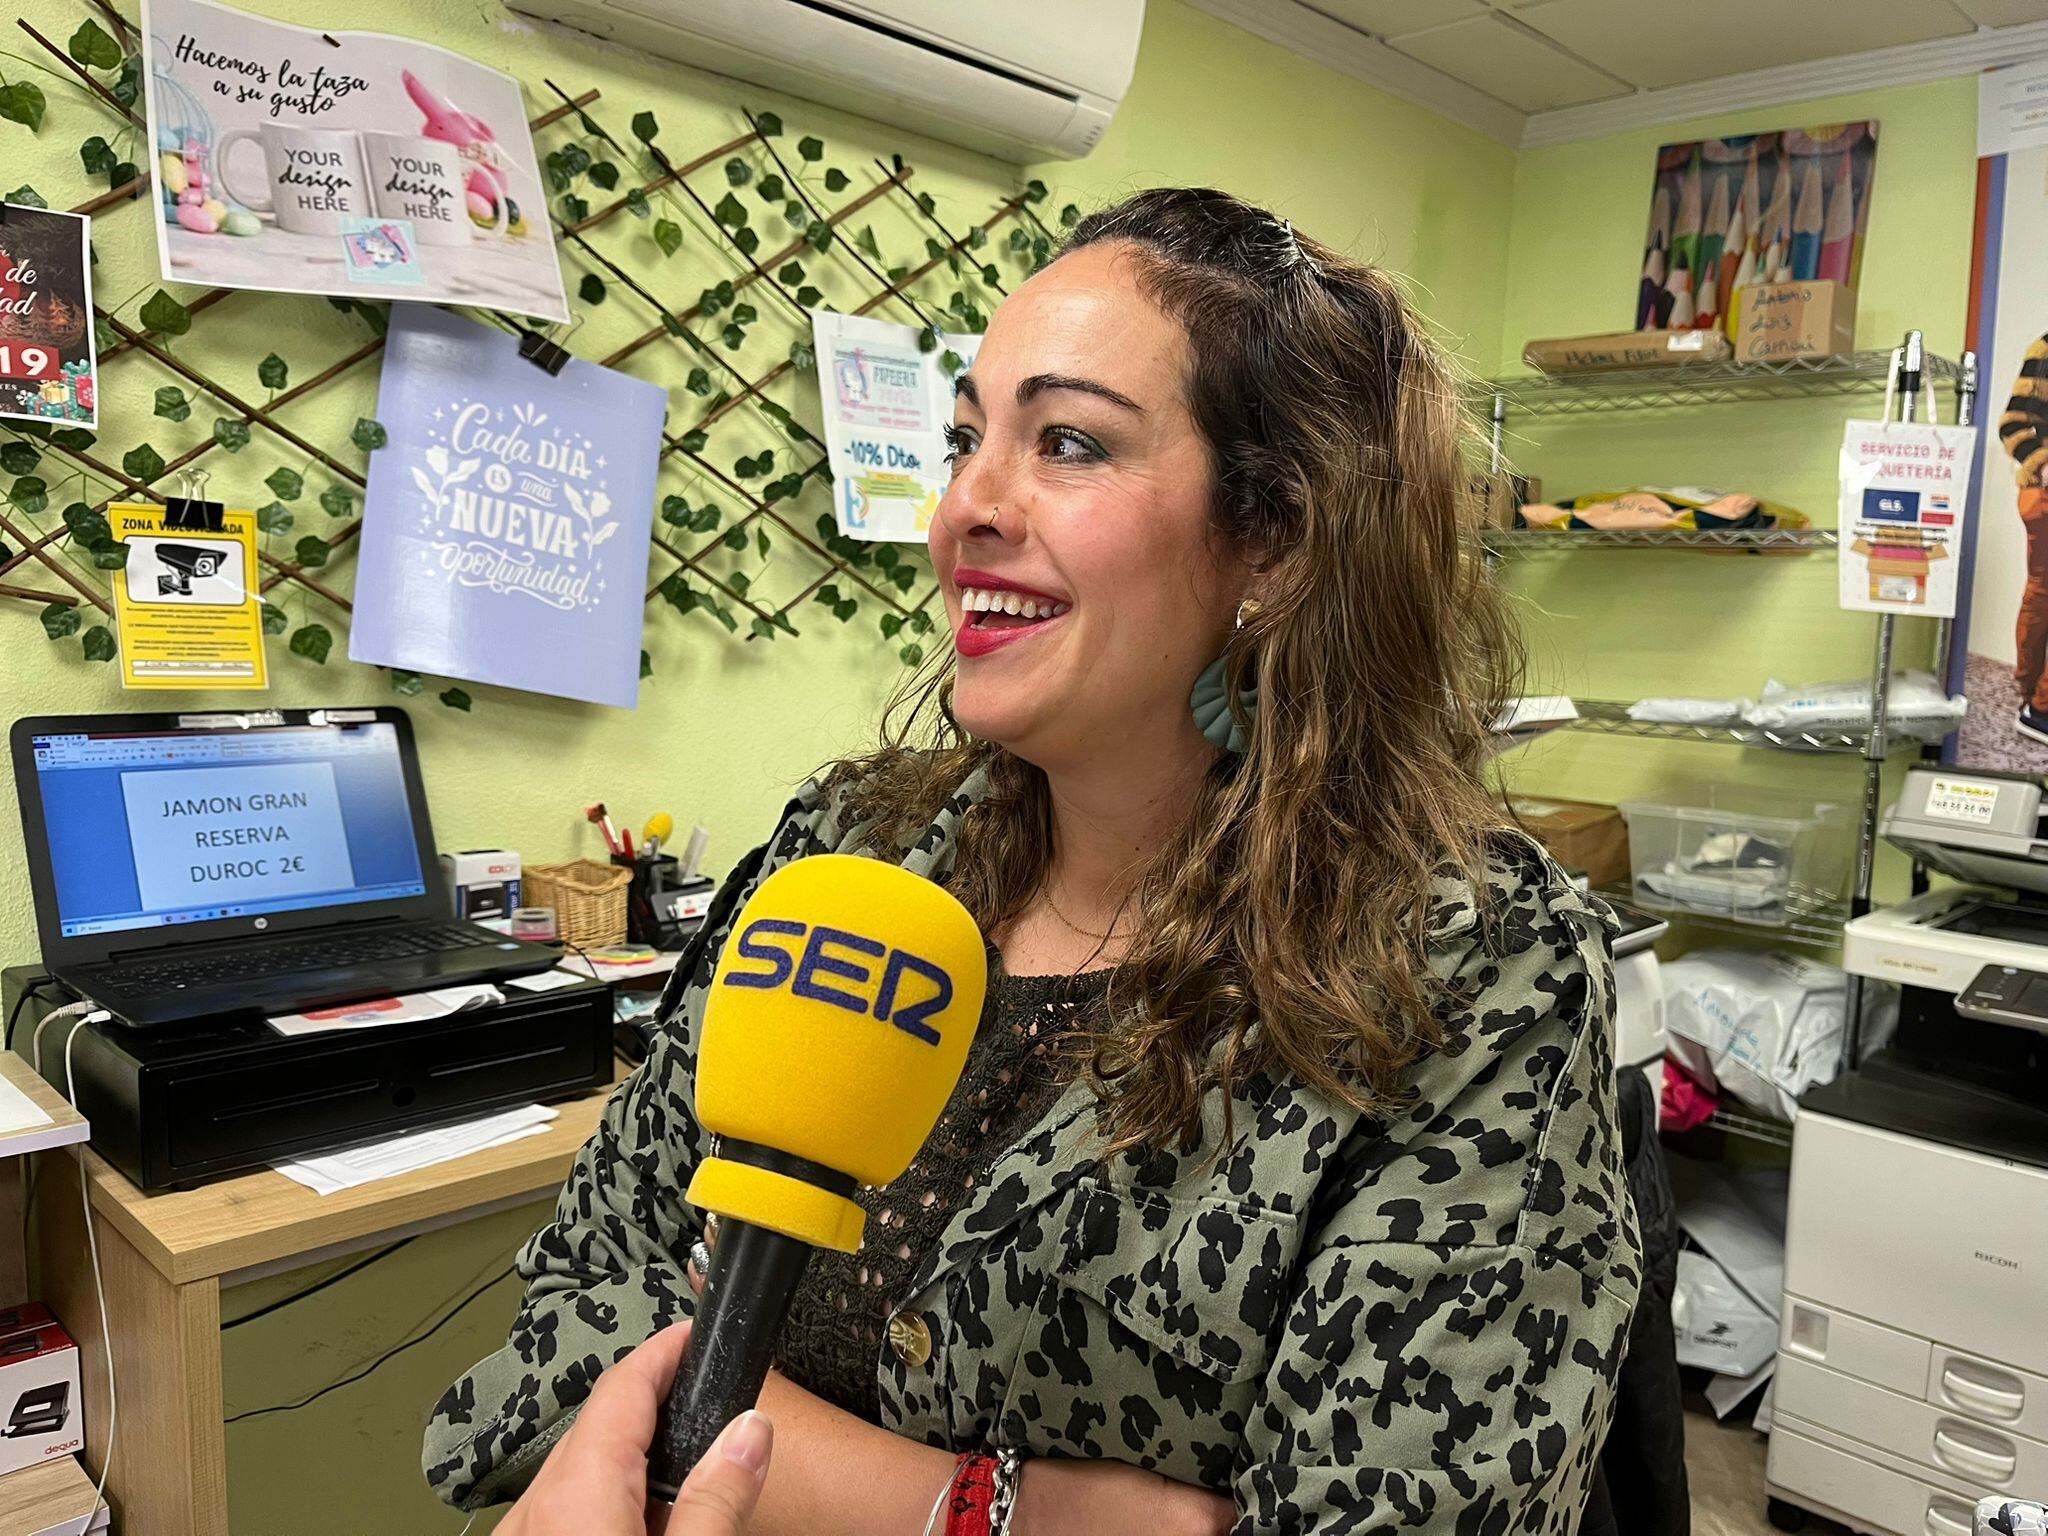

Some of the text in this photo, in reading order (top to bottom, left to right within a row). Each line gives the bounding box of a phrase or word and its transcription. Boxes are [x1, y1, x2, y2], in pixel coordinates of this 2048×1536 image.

[175, 34, 369, 97] Hacemos la taza
[213, 79, 336, 117] a su gusto
[284, 148, 343, 167] YOUR
[390, 157, 445, 178] YOUR
[278, 164, 352, 197] design
[385, 172, 454, 206] design
[297, 195, 351, 212] HERE
[403, 202, 453, 222] HERE
[5, 257, 38, 286] de
[0, 287, 38, 317] ad
[452, 403, 592, 480] Cada DÍA
[843, 440, 884, 467] -10%
[1860, 440, 1956, 460] SERVICIO DE
[520, 478, 553, 501] una
[122, 517, 154, 531] ZONA
[449, 487, 579, 559] NUEVA
[162, 792, 308, 818] JAMON GRAN
[195, 825, 290, 849] RESERVA
[190, 856, 306, 883] DUROC 2€
[723, 918, 954, 1048] SER
[1974, 1250, 2019, 1270] RICOH
[44, 1438, 79, 1455] dequa
